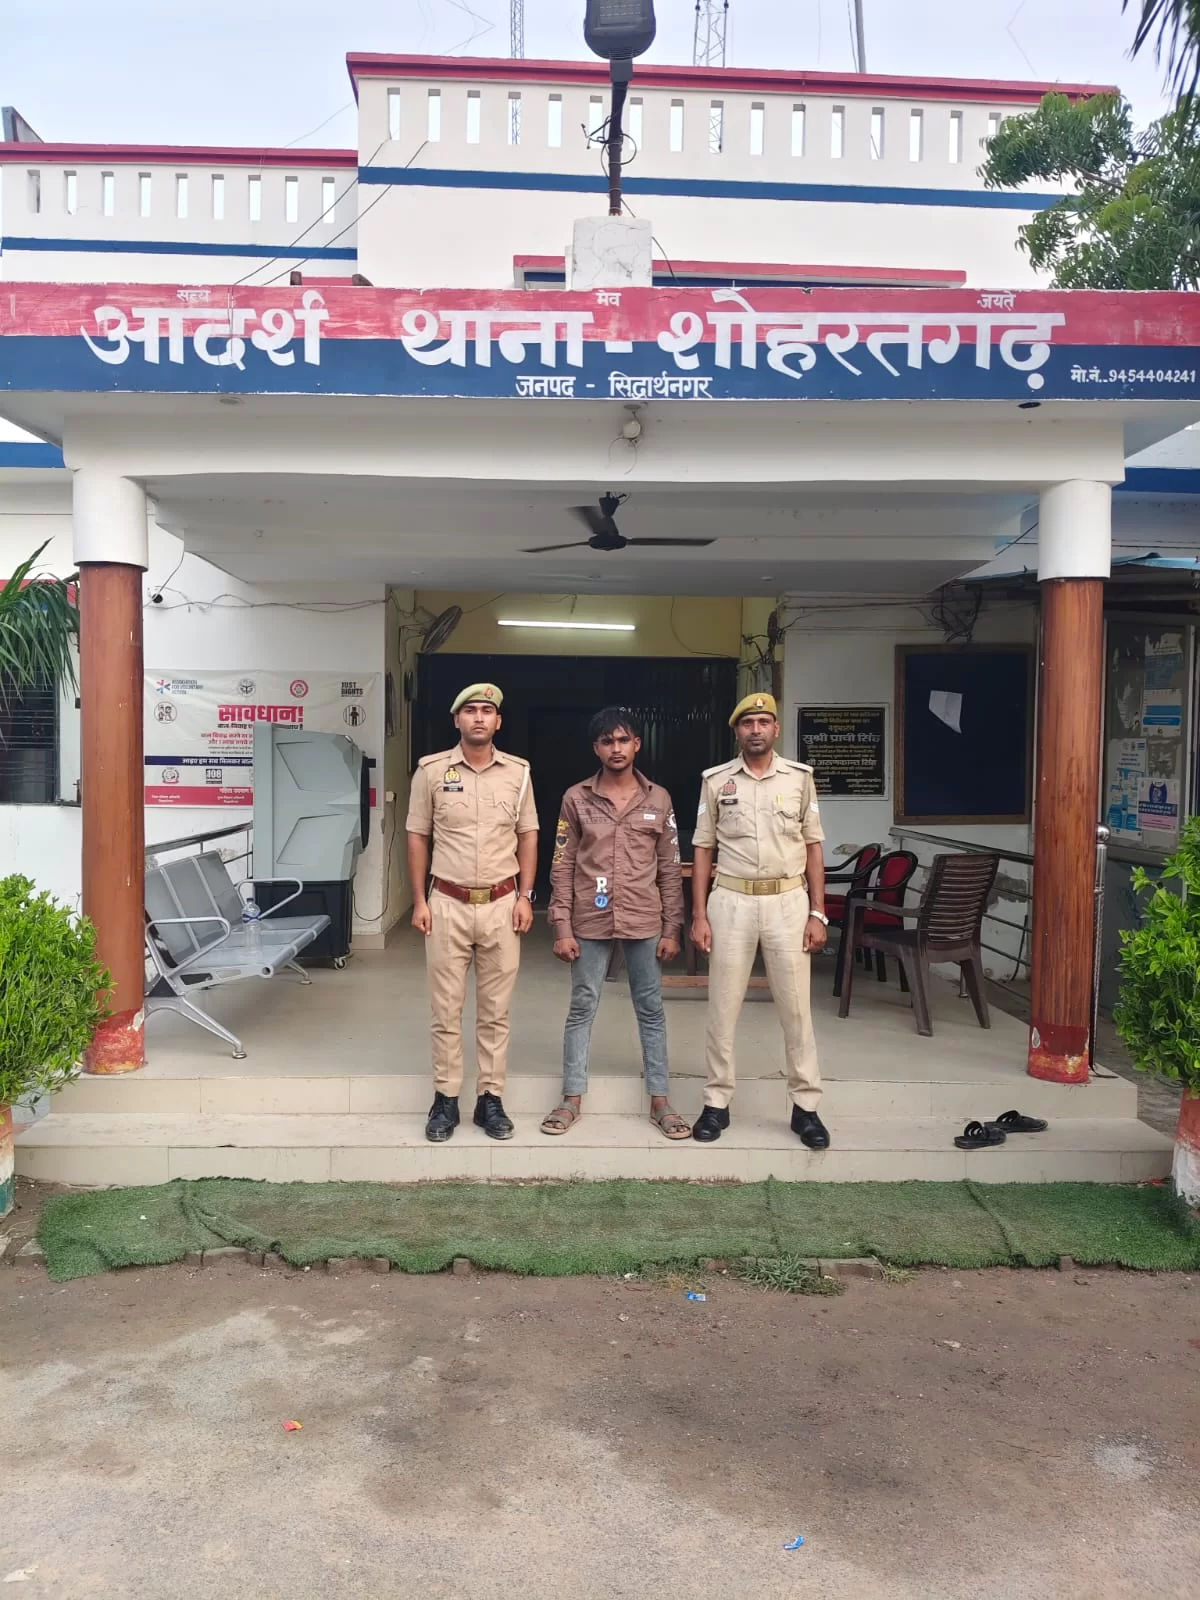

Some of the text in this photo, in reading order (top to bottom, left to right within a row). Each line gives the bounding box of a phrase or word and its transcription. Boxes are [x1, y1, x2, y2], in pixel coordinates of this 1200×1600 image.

[80, 289, 330, 372] आदर्श
[401, 309, 595, 369] थाना
[656, 288, 1066, 390] शोहरतगढ़
[1108, 369, 1197, 383] 9454404241
[515, 375, 577, 397] जनपद
[217, 705, 304, 723] सावधान!
[595, 876, 608, 894] R
